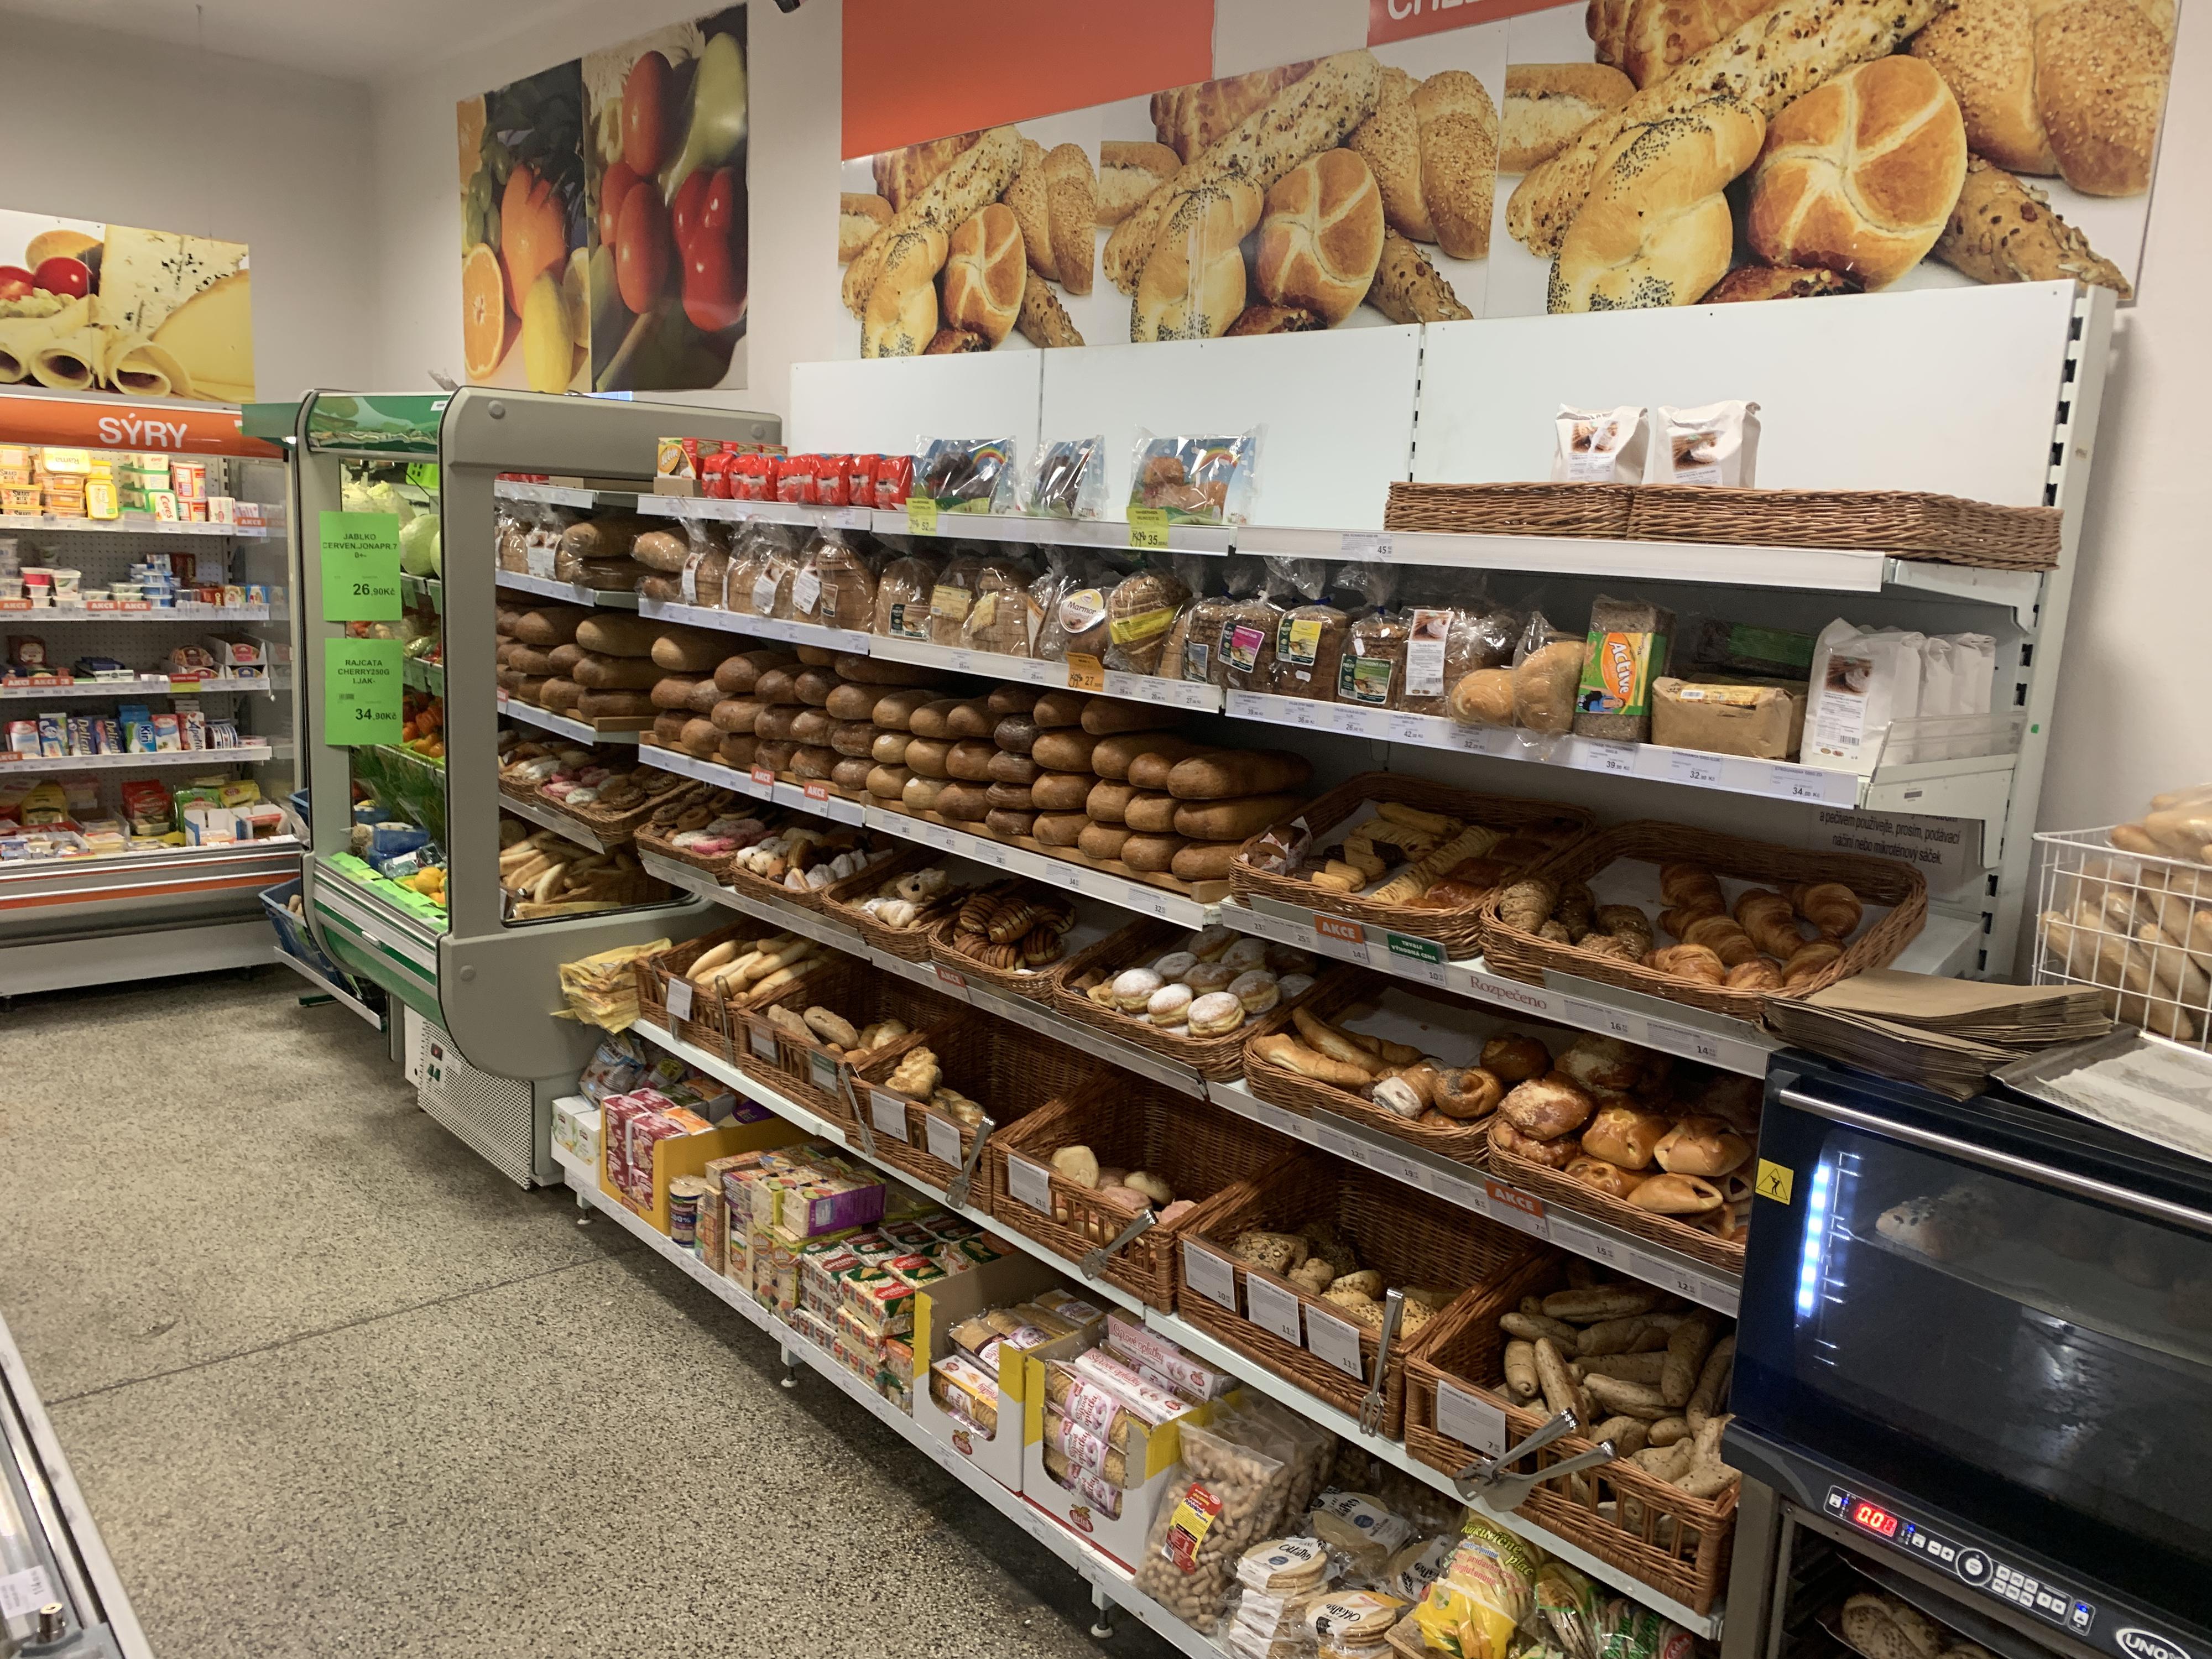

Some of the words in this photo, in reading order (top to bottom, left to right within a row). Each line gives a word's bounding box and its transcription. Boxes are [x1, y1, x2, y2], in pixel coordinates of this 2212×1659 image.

[98, 413, 187, 447] SÝRY
[160, 495, 174, 519] Ceres
[1147, 535, 1158, 545] 35
[1378, 546, 1386, 554] 45
[1067, 601, 1097, 615] Marmor
[1085, 676, 1094, 686] 27
[140, 725, 151, 743] Kiri
[755, 771, 770, 780] AKCE
[807, 785, 825, 797] AKCE
[1322, 921, 1356, 939] AKCE
[1470, 975, 1547, 1009] Rozpečeno
[1610, 1022, 1621, 1031] 16
[1697, 1046, 1709, 1055] 14
[1495, 1187, 1534, 1211] AKCE
[1217, 1291, 1226, 1301] 10
[1113, 1323, 1138, 1348] Sýrové
[1138, 1341, 1165, 1364] oplatky
[1084, 1392, 1102, 1427] oplatky
[2125, 1633, 2183, 1659] UNO
